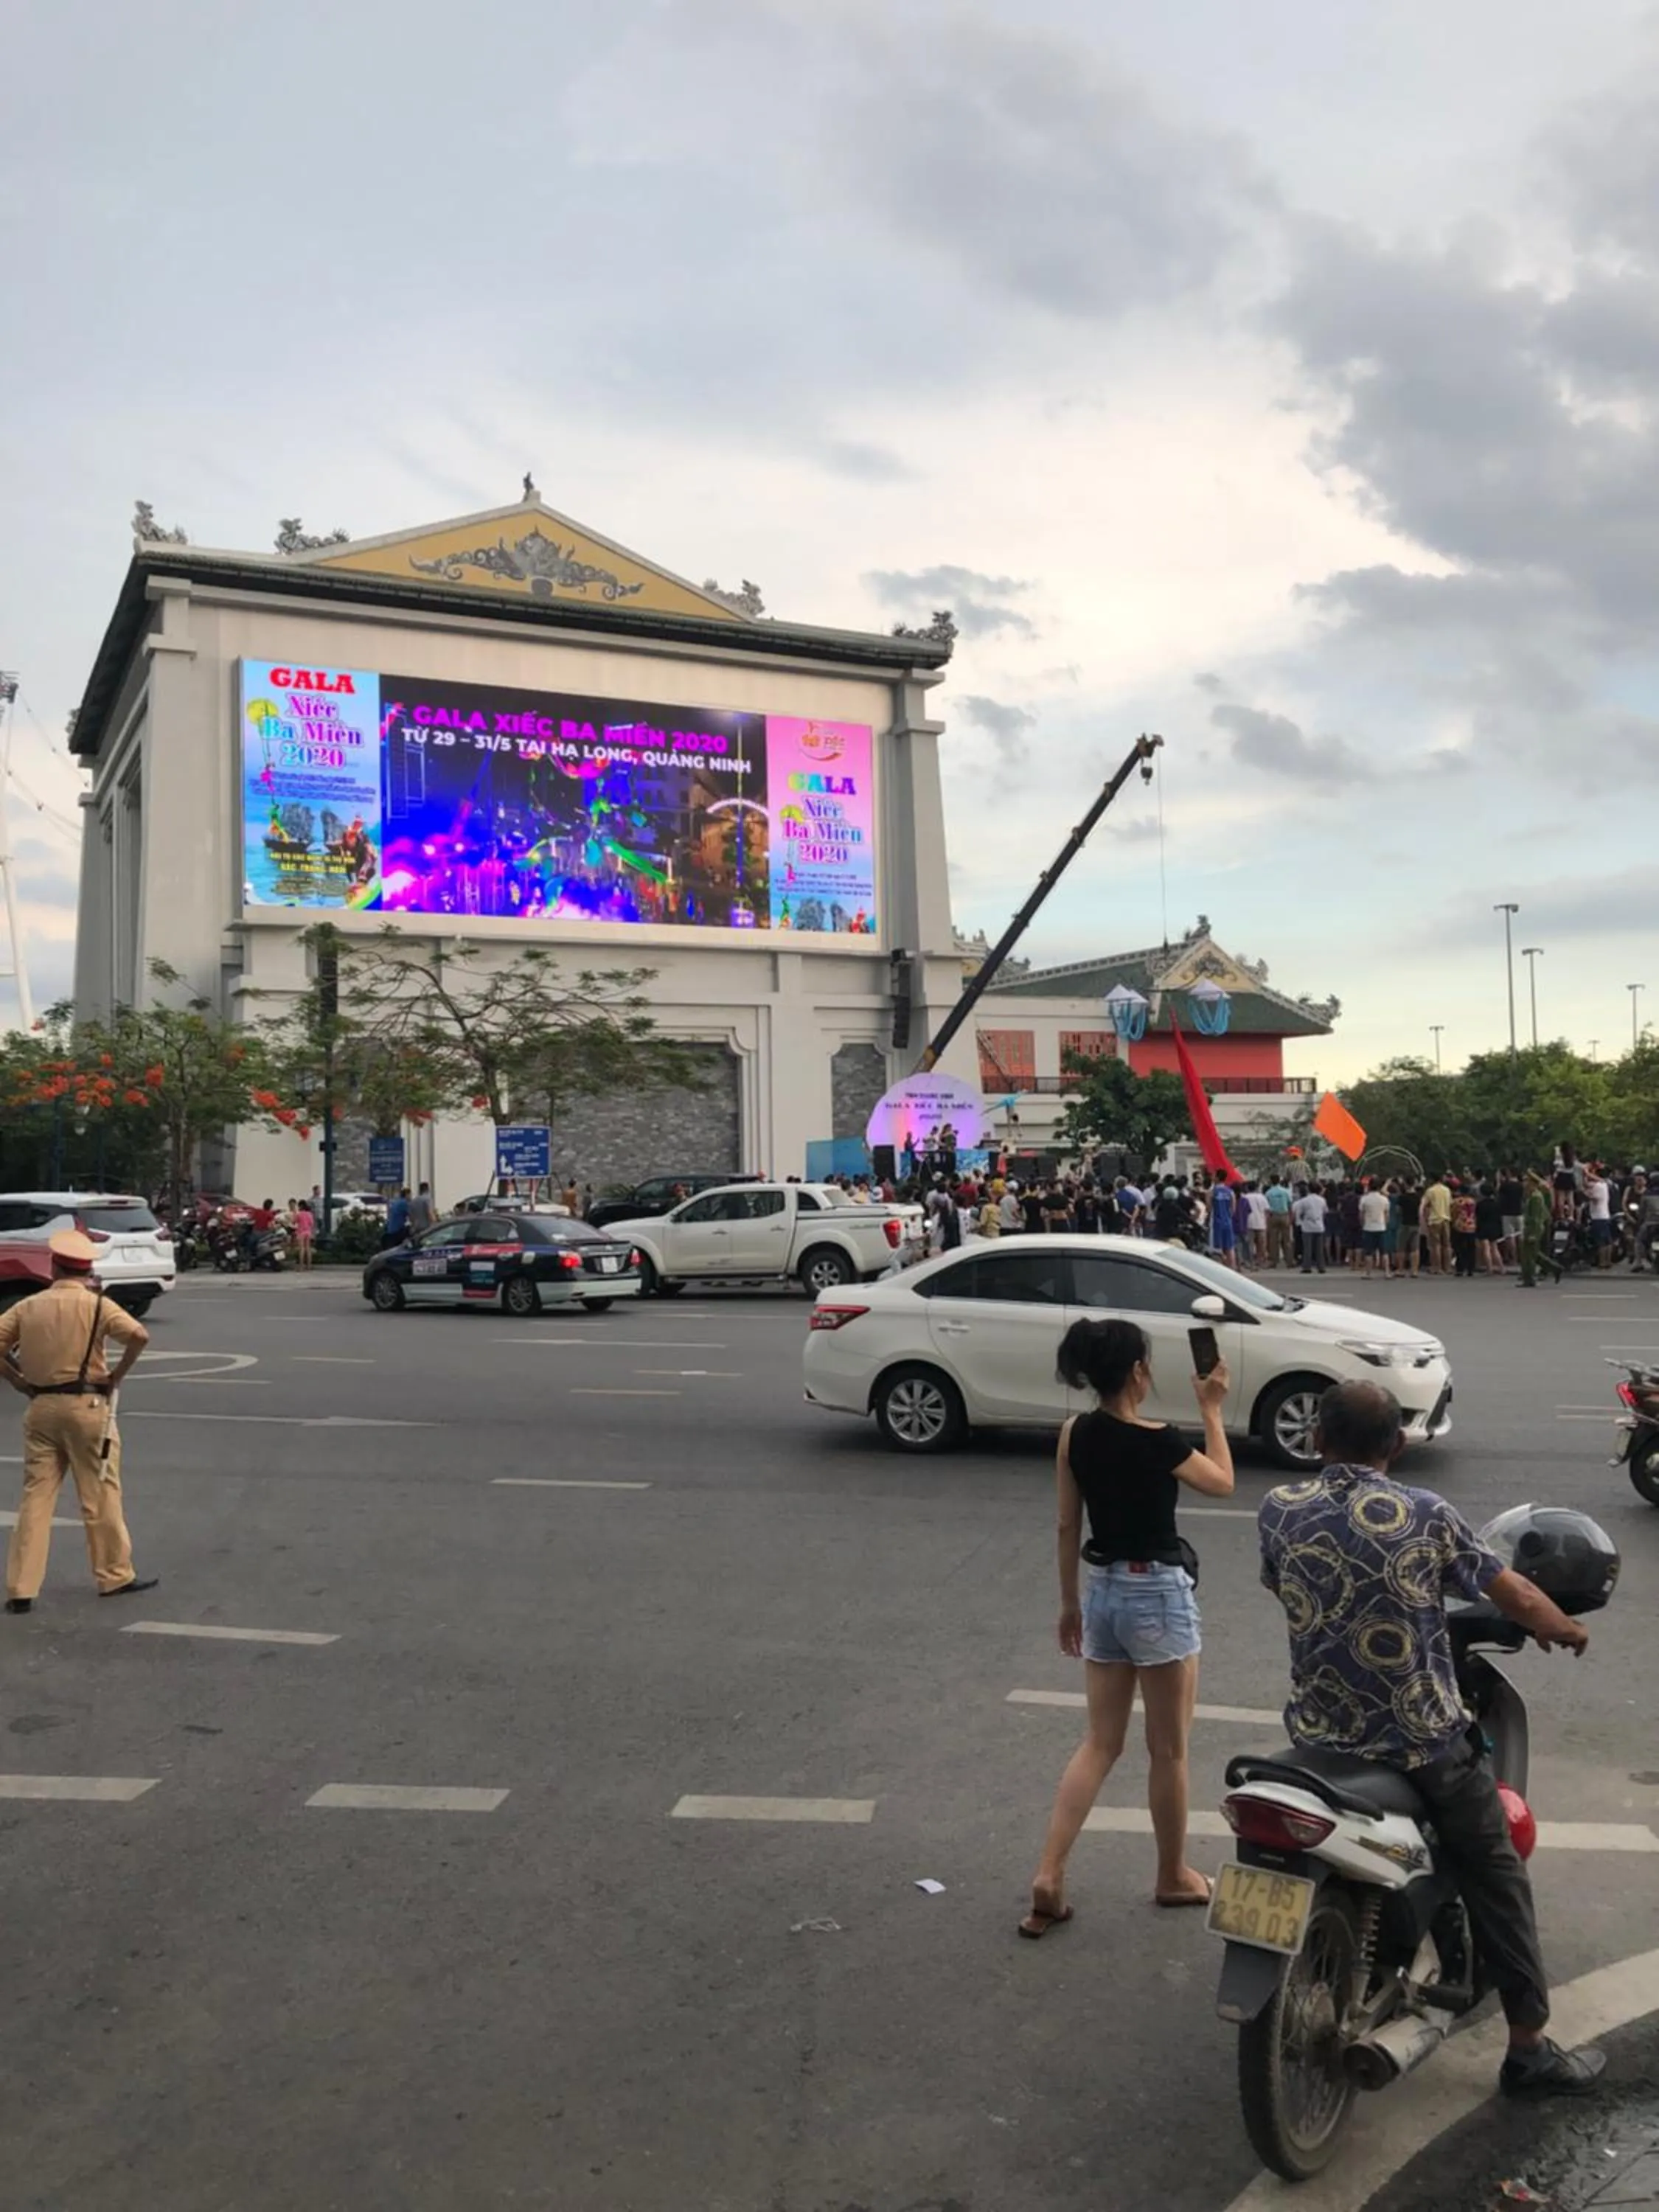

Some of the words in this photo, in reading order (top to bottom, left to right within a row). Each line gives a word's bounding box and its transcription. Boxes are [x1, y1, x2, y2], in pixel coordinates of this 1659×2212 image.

[268, 667, 355, 695] GALA
[263, 717, 294, 740] Ba
[412, 704, 487, 731] GALA
[494, 709, 554, 737] XIẾC
[560, 719, 597, 742] BA
[671, 730, 728, 754] 2020
[281, 741, 344, 767] 2020
[400, 724, 430, 744] TỪ
[432, 731, 456, 746] 29
[473, 734, 512, 752] 31/5
[551, 741, 580, 761] HẠ
[582, 745, 639, 765] LONG,
[642, 749, 705, 769] QUẢNG
[709, 756, 751, 773] NINH
[787, 772, 857, 796] GALA
[799, 843, 849, 863] 2020
